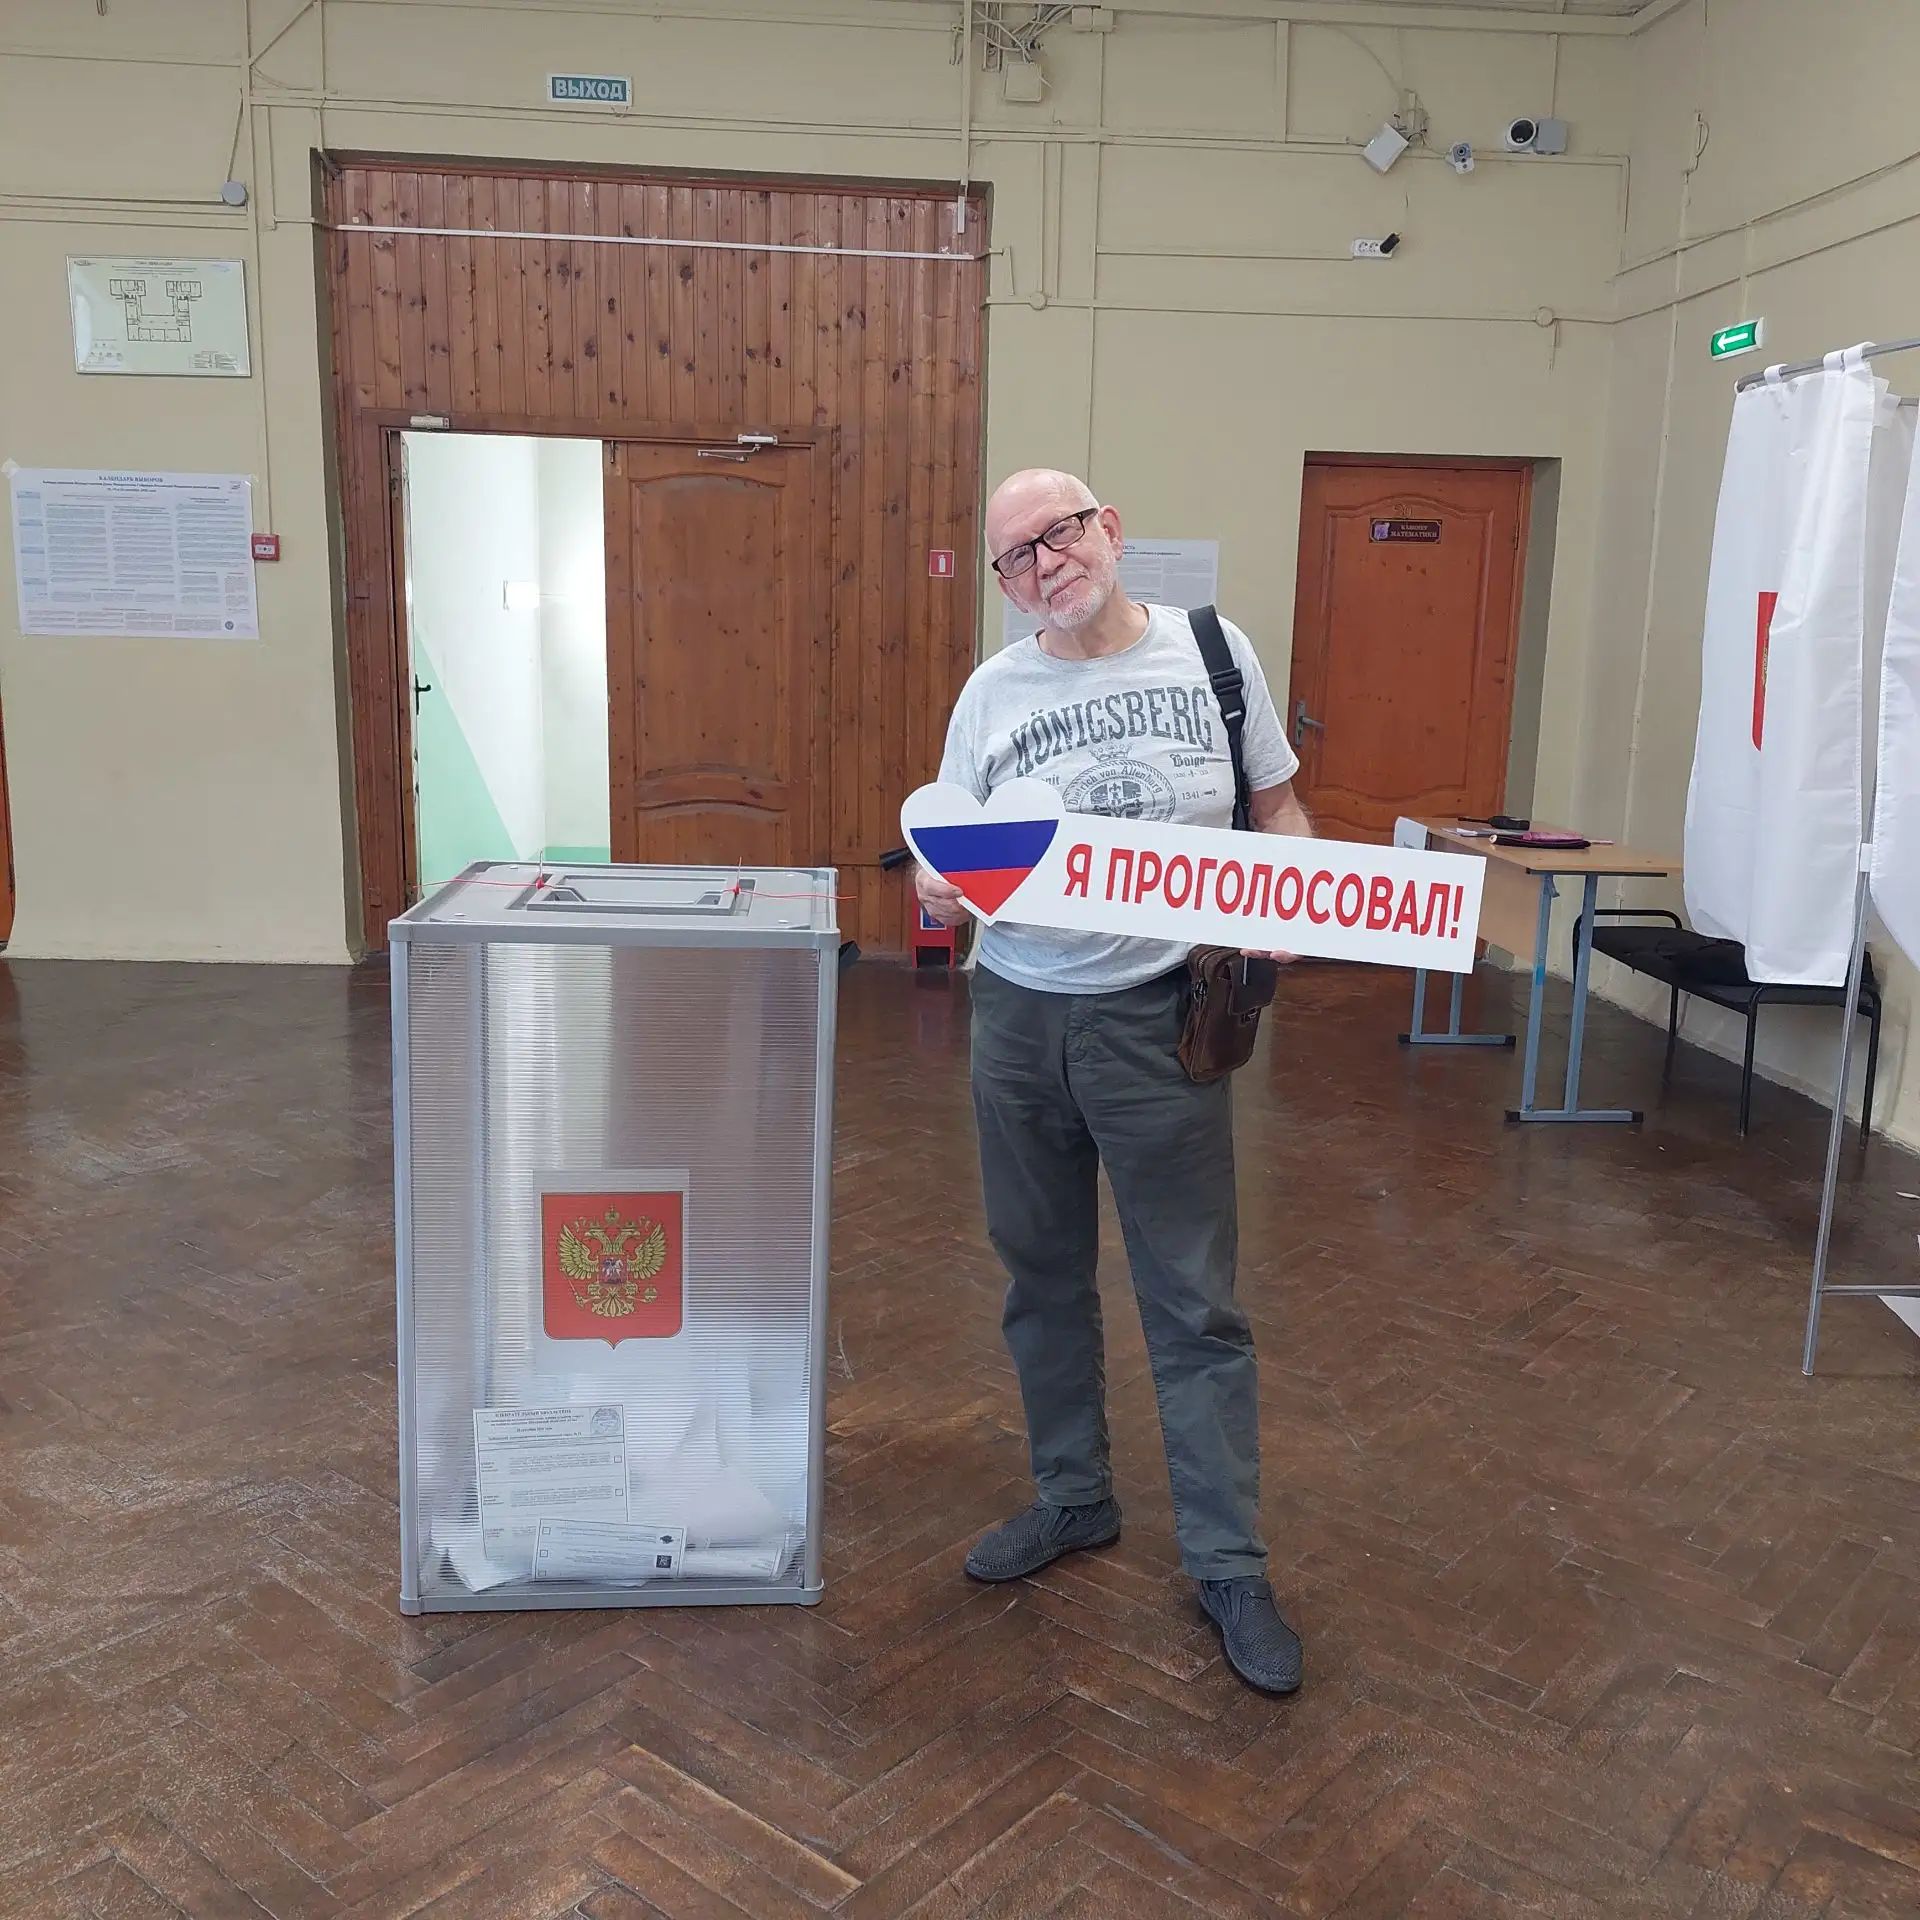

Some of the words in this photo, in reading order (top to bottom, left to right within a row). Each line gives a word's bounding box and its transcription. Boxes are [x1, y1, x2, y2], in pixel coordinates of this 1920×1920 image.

[555, 79, 624, 100] ВЫХОД
[1010, 686, 1214, 777] KÖNIGSBERG
[1100, 768, 1117, 778] von
[1063, 843, 1094, 898] Я
[1104, 847, 1465, 940] ПРОГОЛОСОВАЛ!
